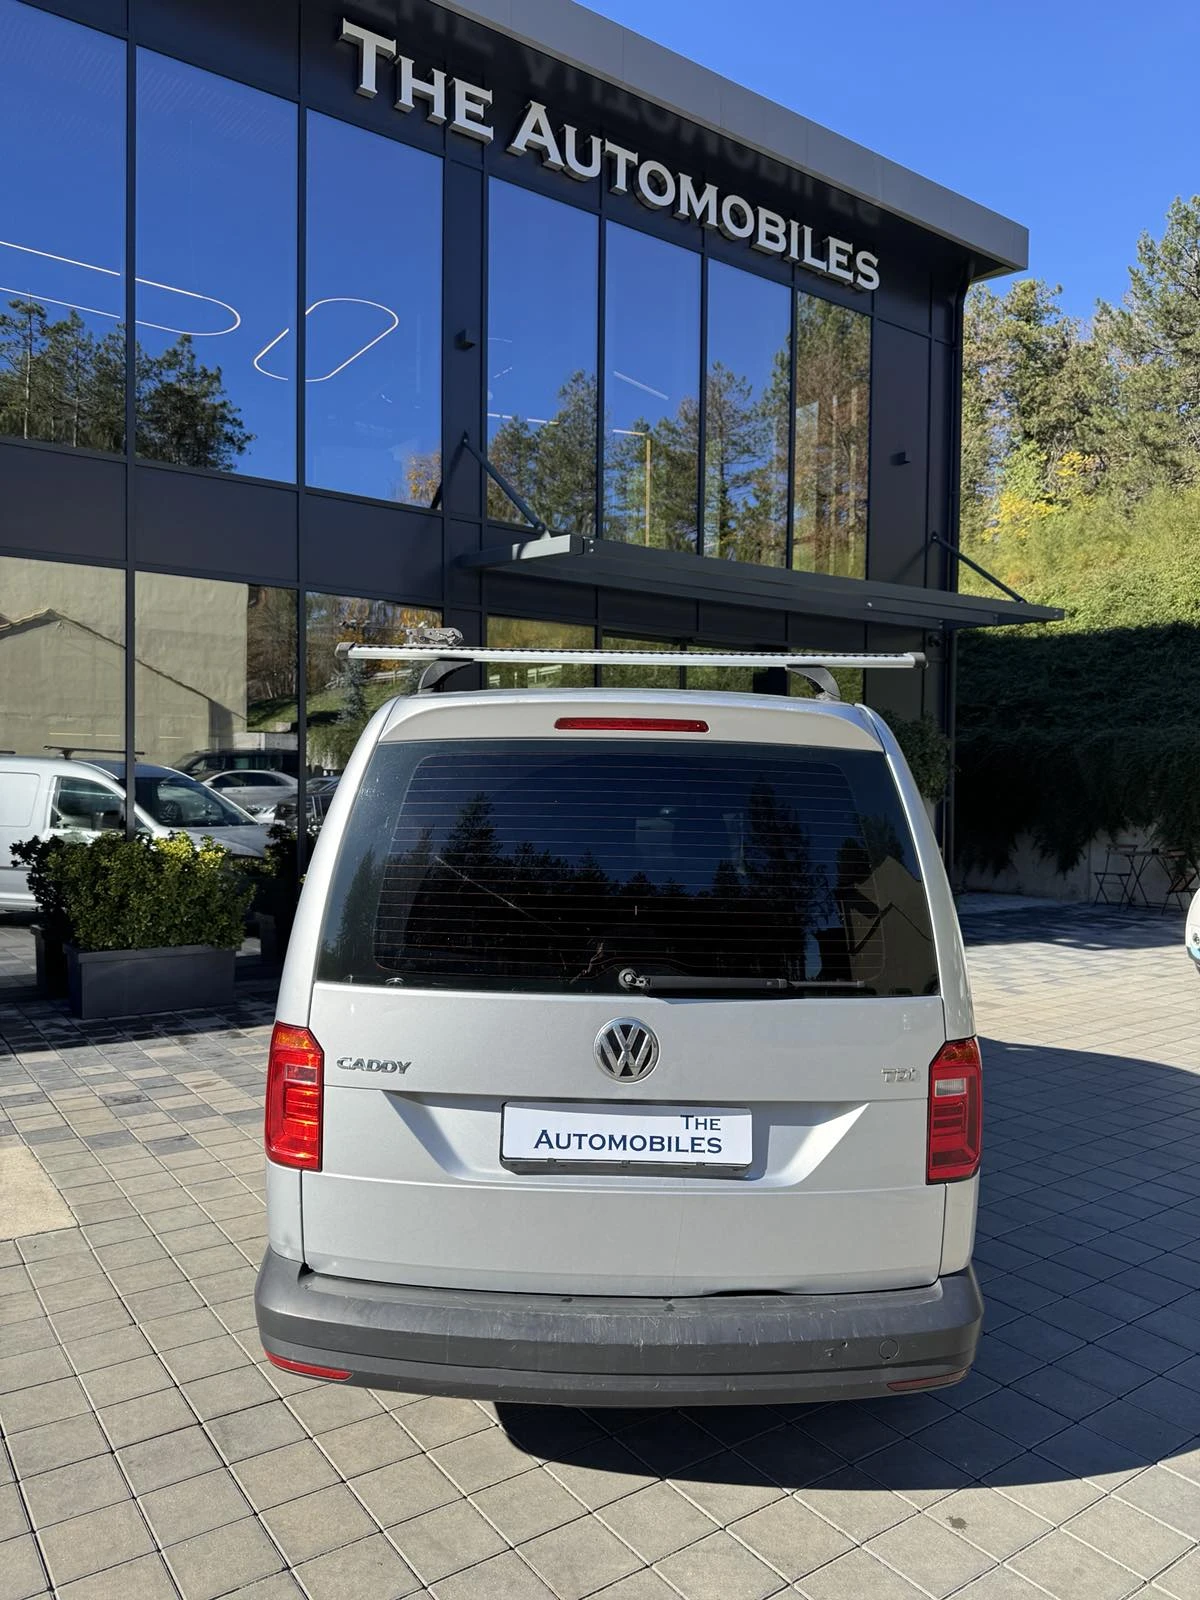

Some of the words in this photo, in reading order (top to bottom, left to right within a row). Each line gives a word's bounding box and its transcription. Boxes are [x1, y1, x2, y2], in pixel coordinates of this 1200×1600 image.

[339, 18, 494, 146] THE
[507, 100, 881, 292] AUTOMOBILES
[336, 1057, 412, 1075] CADDY
[680, 1114, 722, 1131] THE
[533, 1129, 723, 1154] AUTOMOBILES
